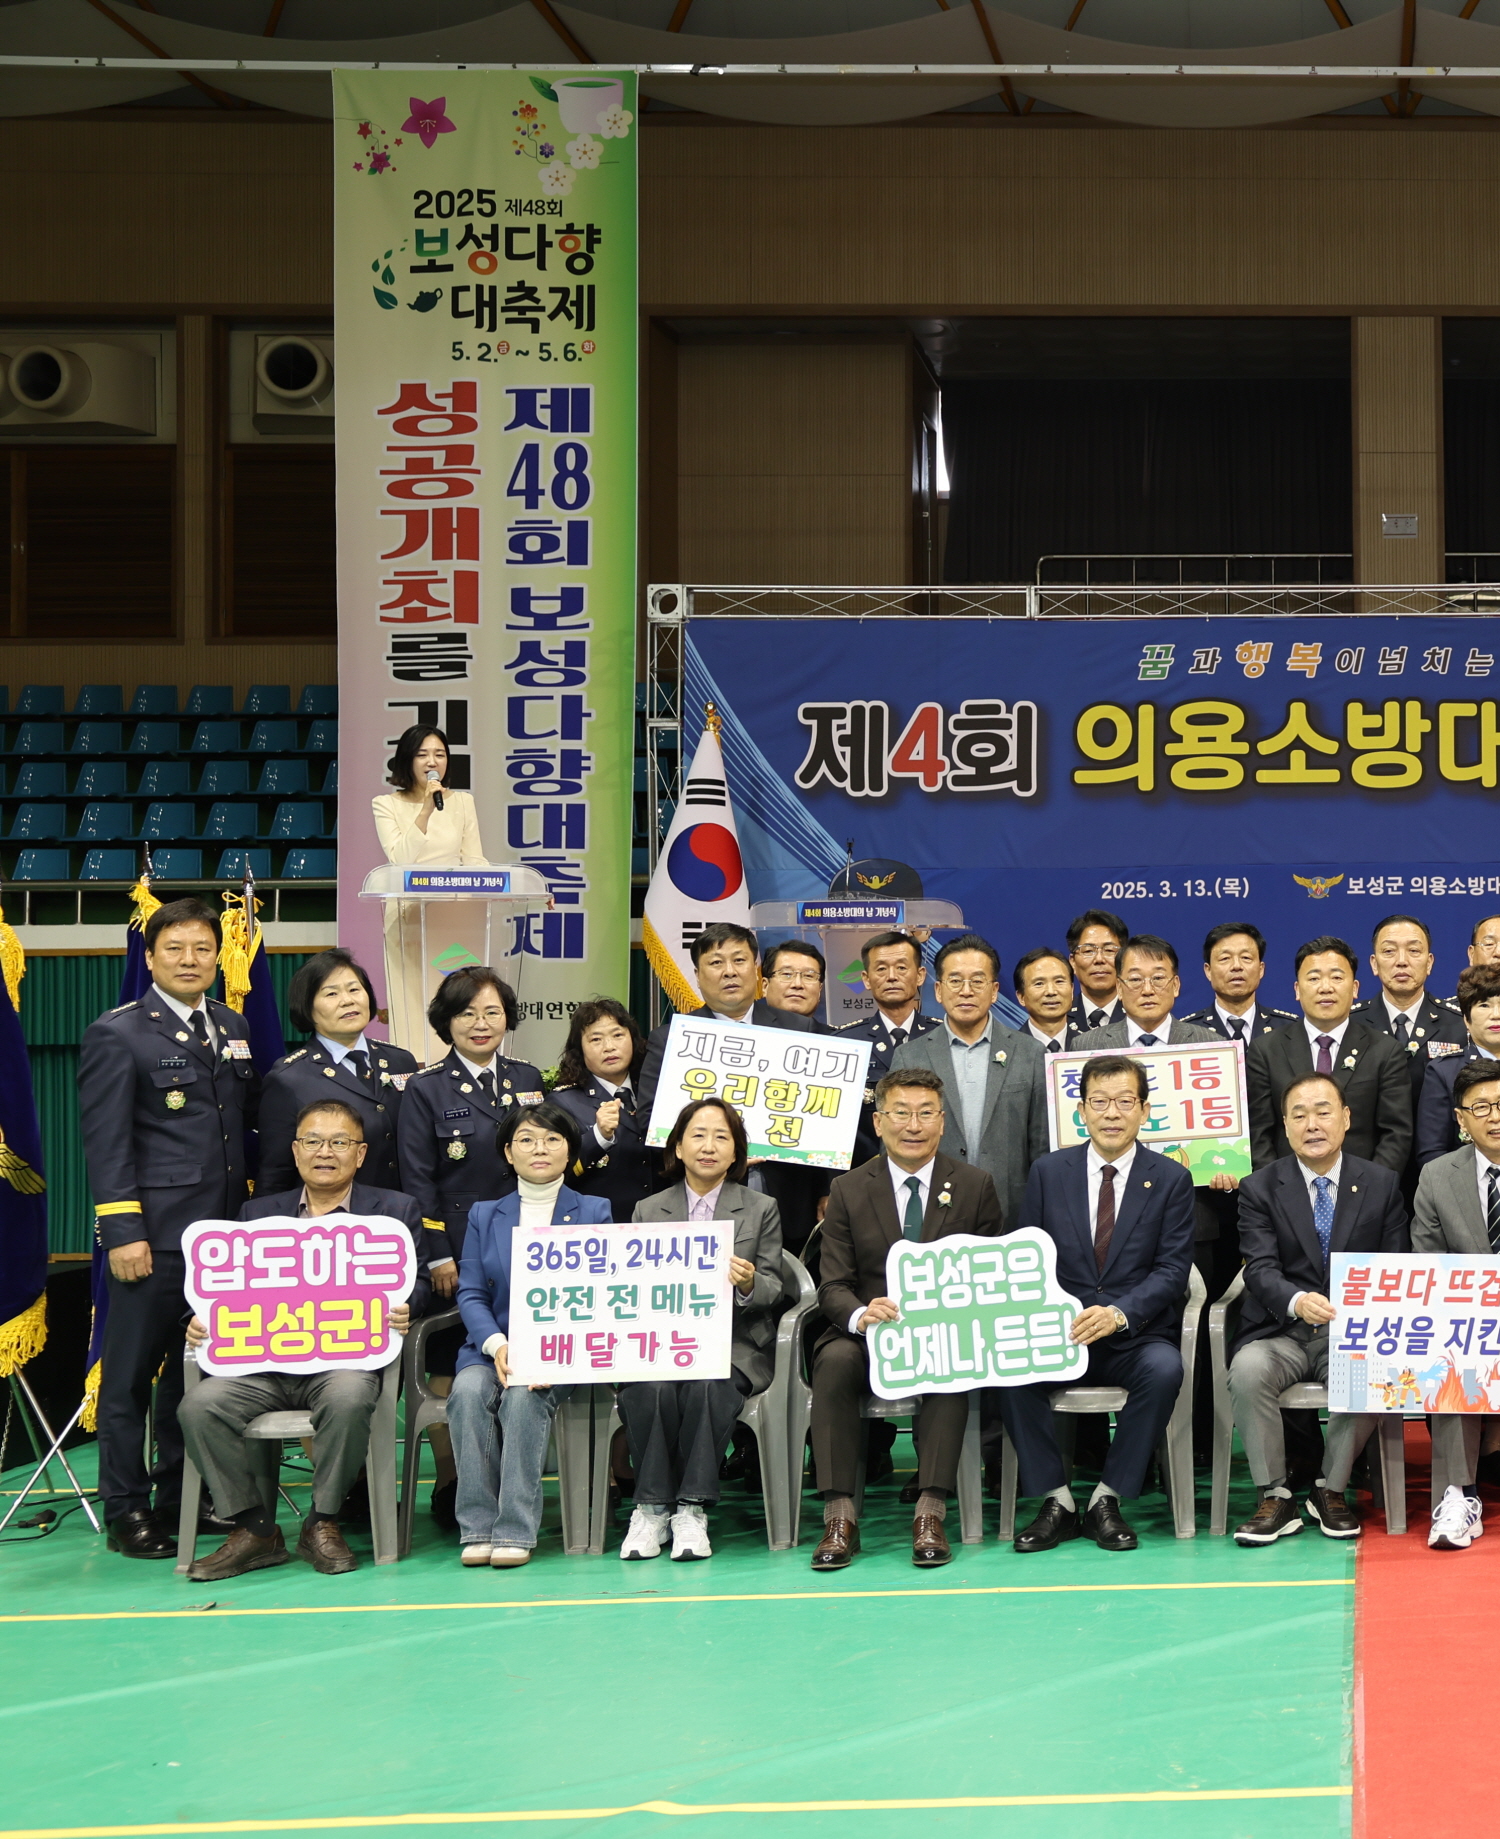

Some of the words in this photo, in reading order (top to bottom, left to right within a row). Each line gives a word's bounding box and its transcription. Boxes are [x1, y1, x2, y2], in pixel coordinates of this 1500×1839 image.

[413, 188, 497, 219] 2025
[504, 198, 564, 218] 제48회
[409, 222, 602, 276] 보성다향
[450, 280, 597, 334] 대축제
[503, 387, 592, 566] 제48회
[376, 381, 482, 682] 성공개최를
[1378, 646, 1494, 677] 넘치는
[796, 699, 1036, 796] 제4회
[412, 877, 429, 887] 제4회
[430, 877, 472, 887] 의용소방대의
[473, 877, 481, 887] 날
[482, 876, 503, 887] 기념식
[1101, 879, 1153, 899] 2025.
[1159, 879, 1178, 898] 3.
[1183, 877, 1250, 898] 13.(목)
[1347, 875, 1404, 896] 보성군
[804, 908, 822, 917] 제4회
[822, 907, 865, 918] 의용소방대의
[865, 908, 874, 918] 날
[875, 907, 896, 918] 기념식
[843, 998, 874, 1010] 보성군
[677, 1031, 769, 1072] 지금,
[783, 1045, 859, 1083] 여기
[1168, 1057, 1222, 1091] 1등
[1180, 1096, 1234, 1130] 1등
[199, 1232, 401, 1292] 압도하는
[526, 1237, 617, 1275] 365일,
[626, 1235, 719, 1270] 24시간
[903, 1247, 1042, 1311] 보성군은
[1342, 1267, 1436, 1306] 불보다
[526, 1285, 594, 1322] 안전
[606, 1284, 638, 1320] 전
[651, 1283, 716, 1317] 메뉴
[214, 1298, 383, 1358] 보성군!
[879, 1319, 986, 1382] 언제나
[994, 1309, 1075, 1369] 든든!
[1338, 1316, 1435, 1355] 보성을
